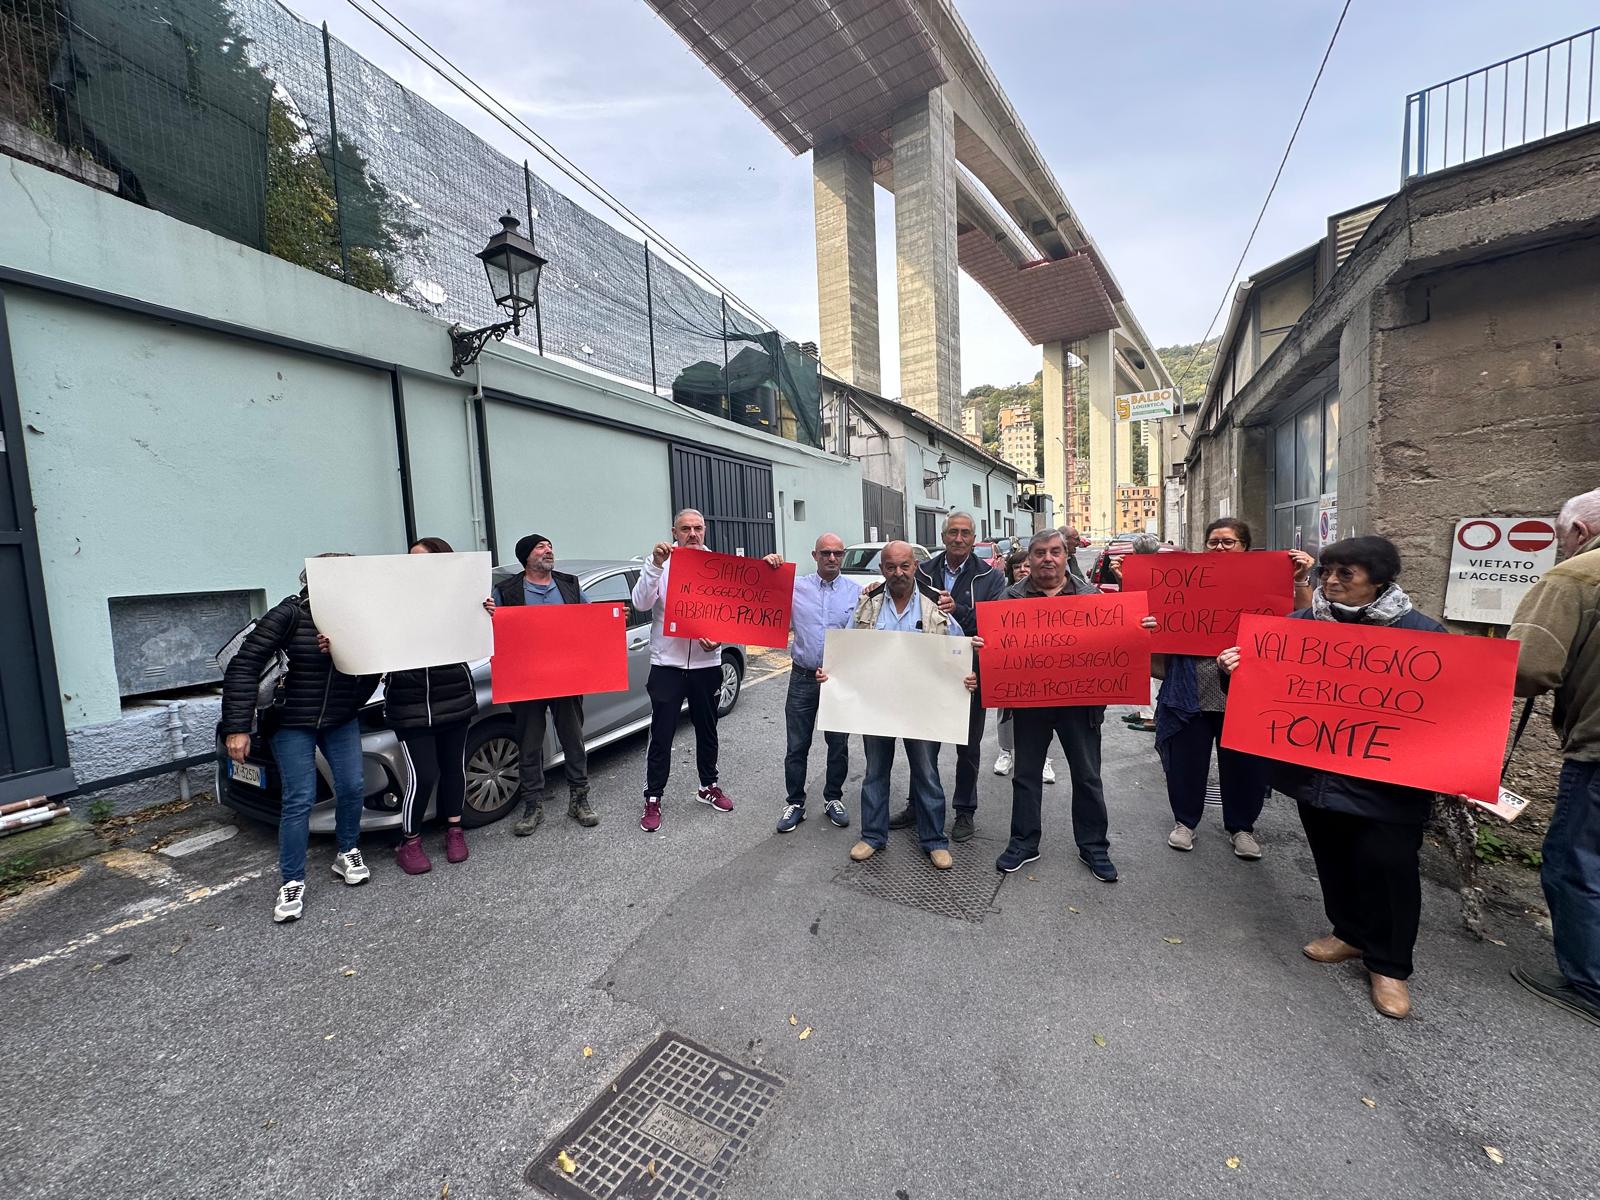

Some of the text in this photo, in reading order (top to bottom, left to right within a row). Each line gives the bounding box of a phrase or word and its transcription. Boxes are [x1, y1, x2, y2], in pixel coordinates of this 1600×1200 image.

[1131, 390, 1171, 404] BALBO
[697, 559, 760, 586] SIAMO
[1469, 559, 1534, 570] VIETATO
[1458, 571, 1540, 584] L'ACCESSO
[680, 582, 772, 603] IN SOGGEZIONE
[1164, 590, 1185, 605] LA
[1000, 603, 1124, 629] VIA PIACENZA
[1000, 636, 1019, 649] VIA
[1286, 674, 1423, 713] PERICOLO
[1258, 709, 1400, 762] PONTE
